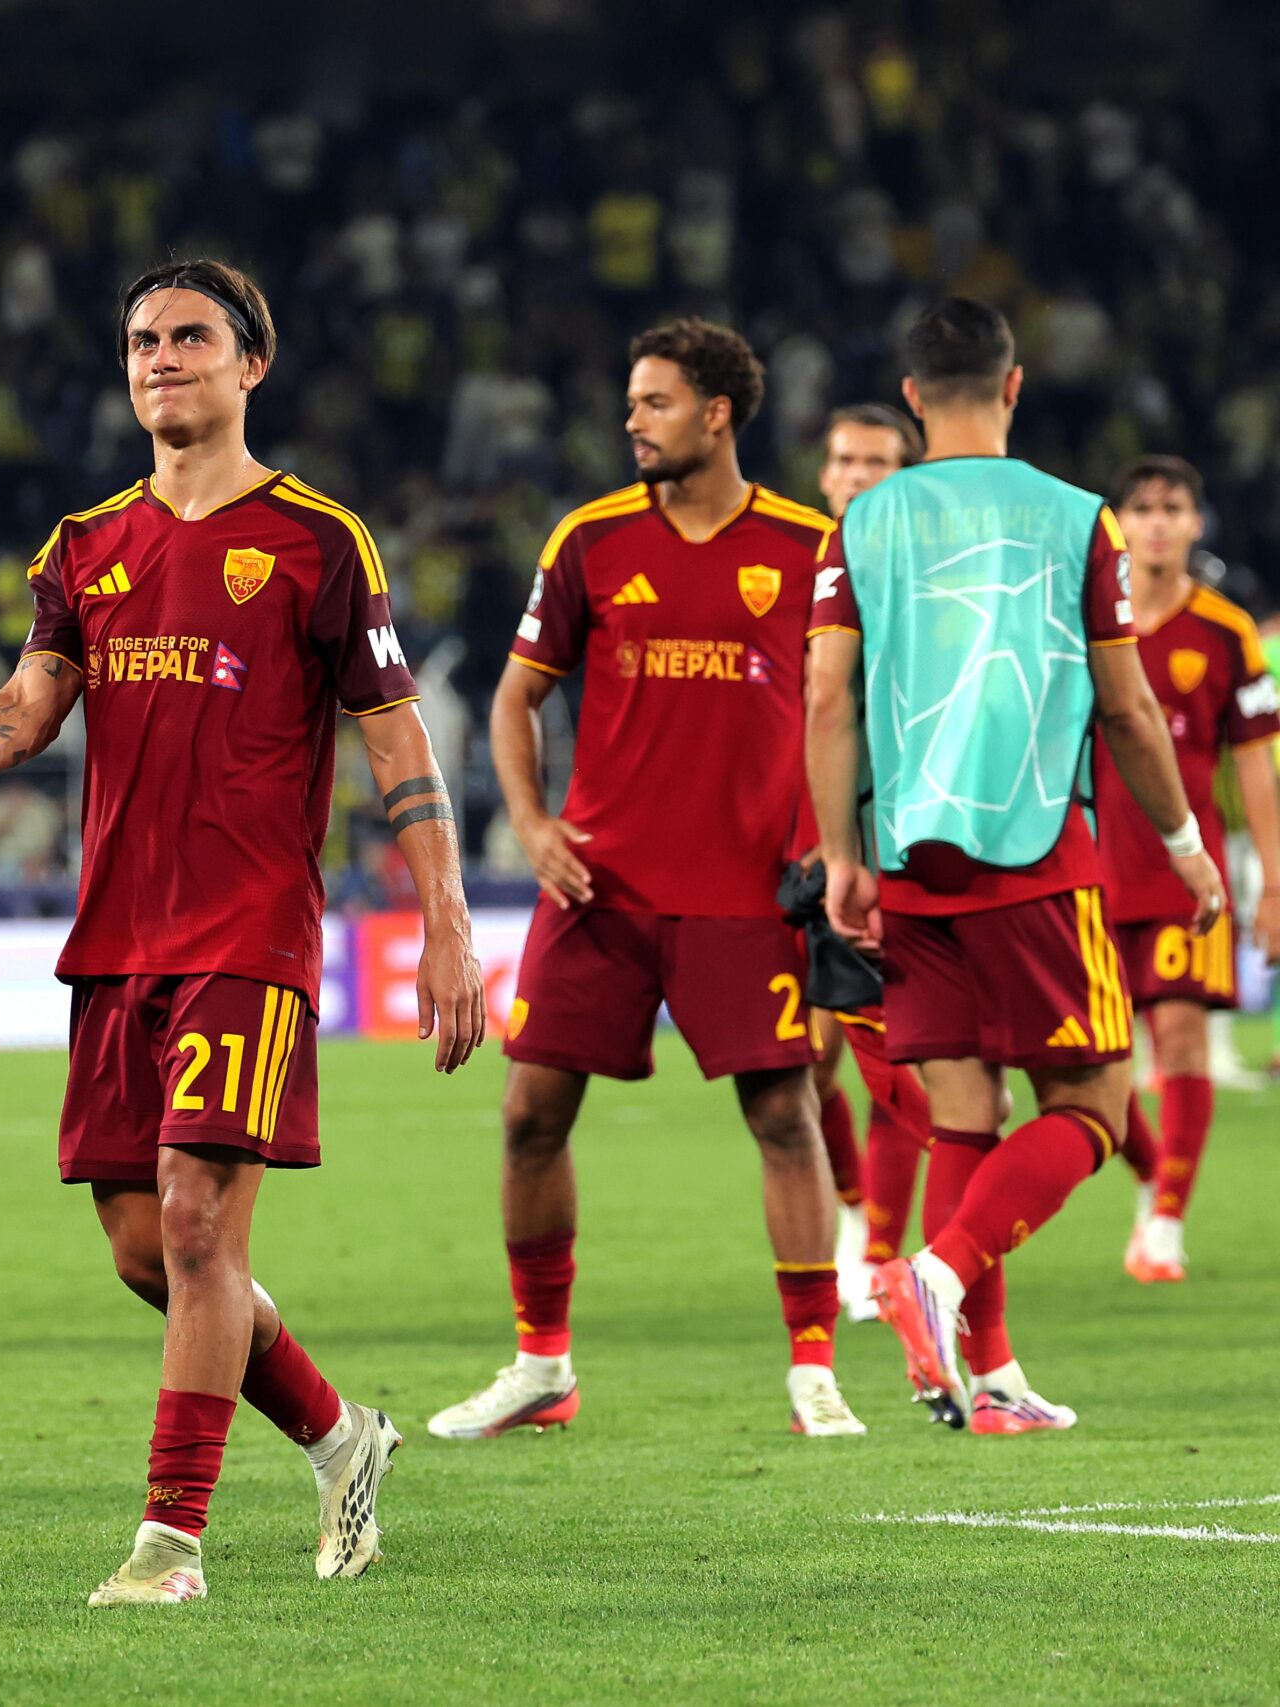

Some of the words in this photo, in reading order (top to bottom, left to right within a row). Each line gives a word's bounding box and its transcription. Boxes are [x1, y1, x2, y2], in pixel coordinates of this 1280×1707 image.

[108, 635, 176, 652] TOGETHER
[179, 636, 209, 652] FOR
[108, 650, 204, 684] NEPAL
[645, 651, 743, 681] NEPAL
[769, 973, 806, 1041] 2
[172, 1032, 245, 1113] 21
